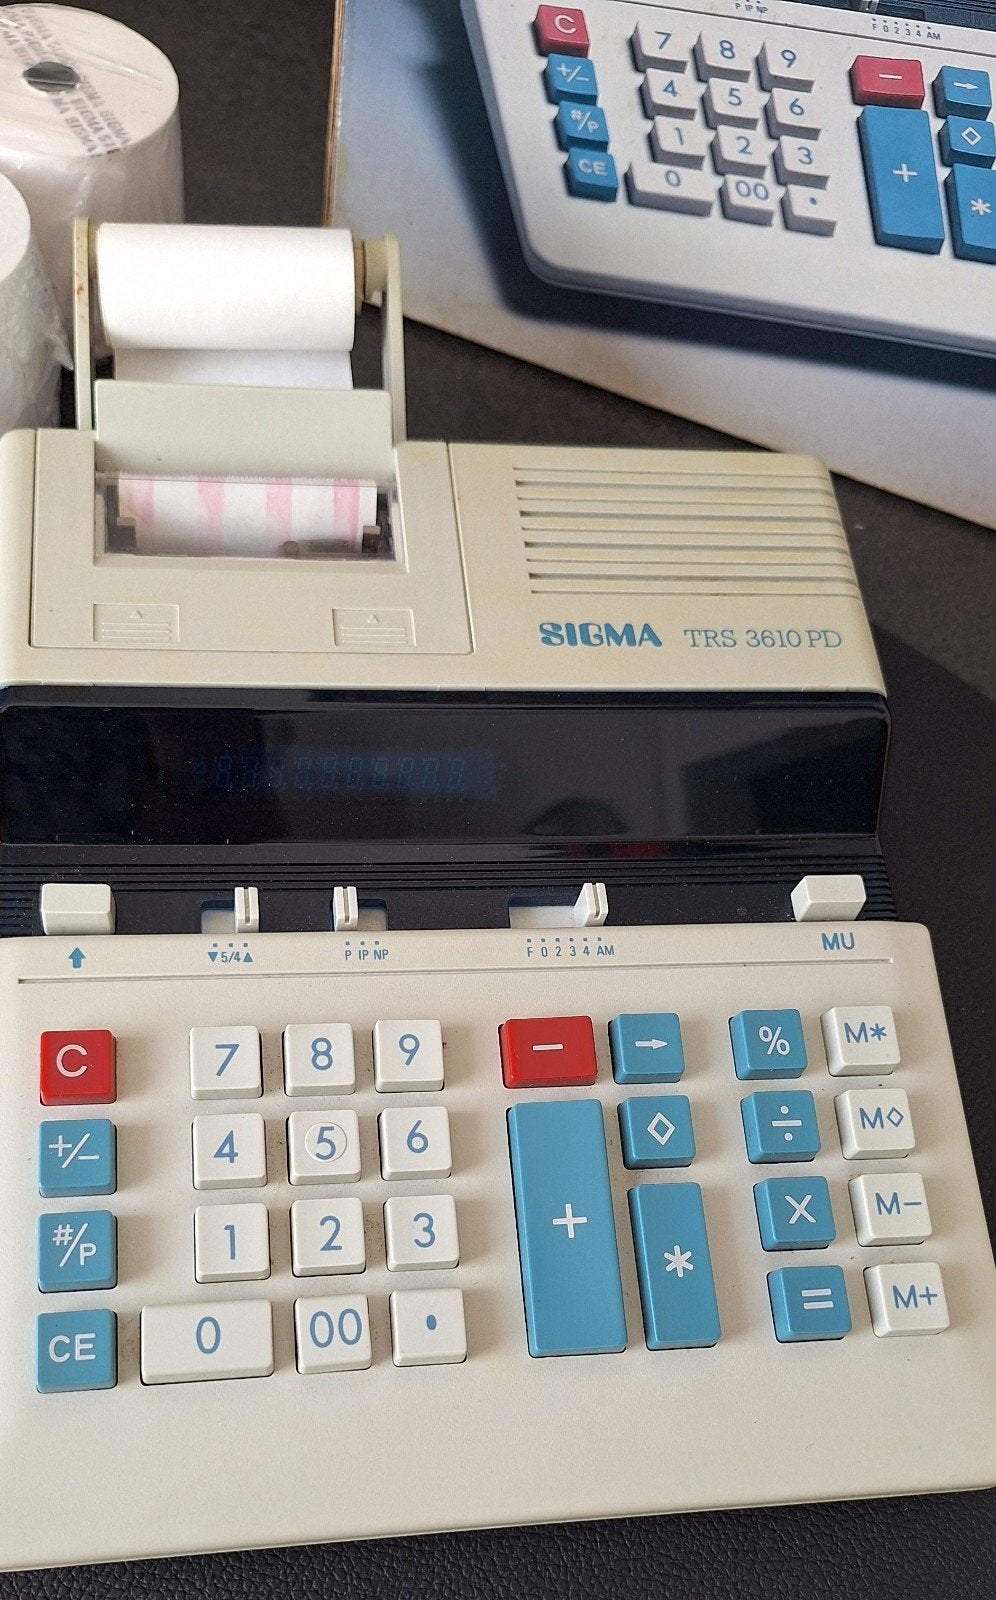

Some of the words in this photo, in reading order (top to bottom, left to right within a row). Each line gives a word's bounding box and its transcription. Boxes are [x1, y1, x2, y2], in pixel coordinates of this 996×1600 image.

[554, 14, 577, 34] C
[894, 27, 900, 35] 2
[905, 28, 911, 36] 3
[916, 30, 922, 38] 4
[926, 31, 941, 41] AM
[655, 32, 672, 49] 7
[719, 39, 736, 59] 8
[781, 49, 797, 68] 9
[663, 79, 678, 97] 4
[727, 88, 742, 106] 5
[790, 98, 805, 116] 6
[675, 127, 683, 146] 1
[736, 136, 752, 155] 2
[797, 146, 813, 165] 3
[578, 159, 606, 177] CE
[665, 170, 682, 188] 0
[736, 180, 769, 201] 00
[538, 622, 662, 647] SIGMA
[683, 629, 736, 648] TRS
[746, 630, 801, 648] 3610
[804, 630, 842, 648] PD
[221, 951, 241, 963] 5/4
[344, 950, 352, 960] P
[358, 950, 369, 961] IP
[374, 948, 389, 960] NP
[526, 947, 533, 957] F
[541, 946, 548, 957] 0
[555, 946, 562, 957] 2
[569, 946, 576, 957] 3
[583, 946, 590, 956] 4
[597, 945, 615, 956] AM
[821, 932, 856, 951] MU
[56, 1044, 88, 1078] C
[214, 1043, 239, 1077] 7
[311, 1037, 333, 1070] 8
[398, 1033, 420, 1066] 9
[213, 1130, 239, 1163] 4
[315, 1126, 337, 1161] 5
[406, 1120, 429, 1154] 6
[52, 1222, 97, 1267] #/P
[224, 1224, 237, 1260] 1
[319, 1216, 343, 1251] 2
[413, 1212, 436, 1248] 3
[195, 1316, 221, 1354] 0
[309, 1308, 362, 1348] 00
[48, 1333, 96, 1362] CE
